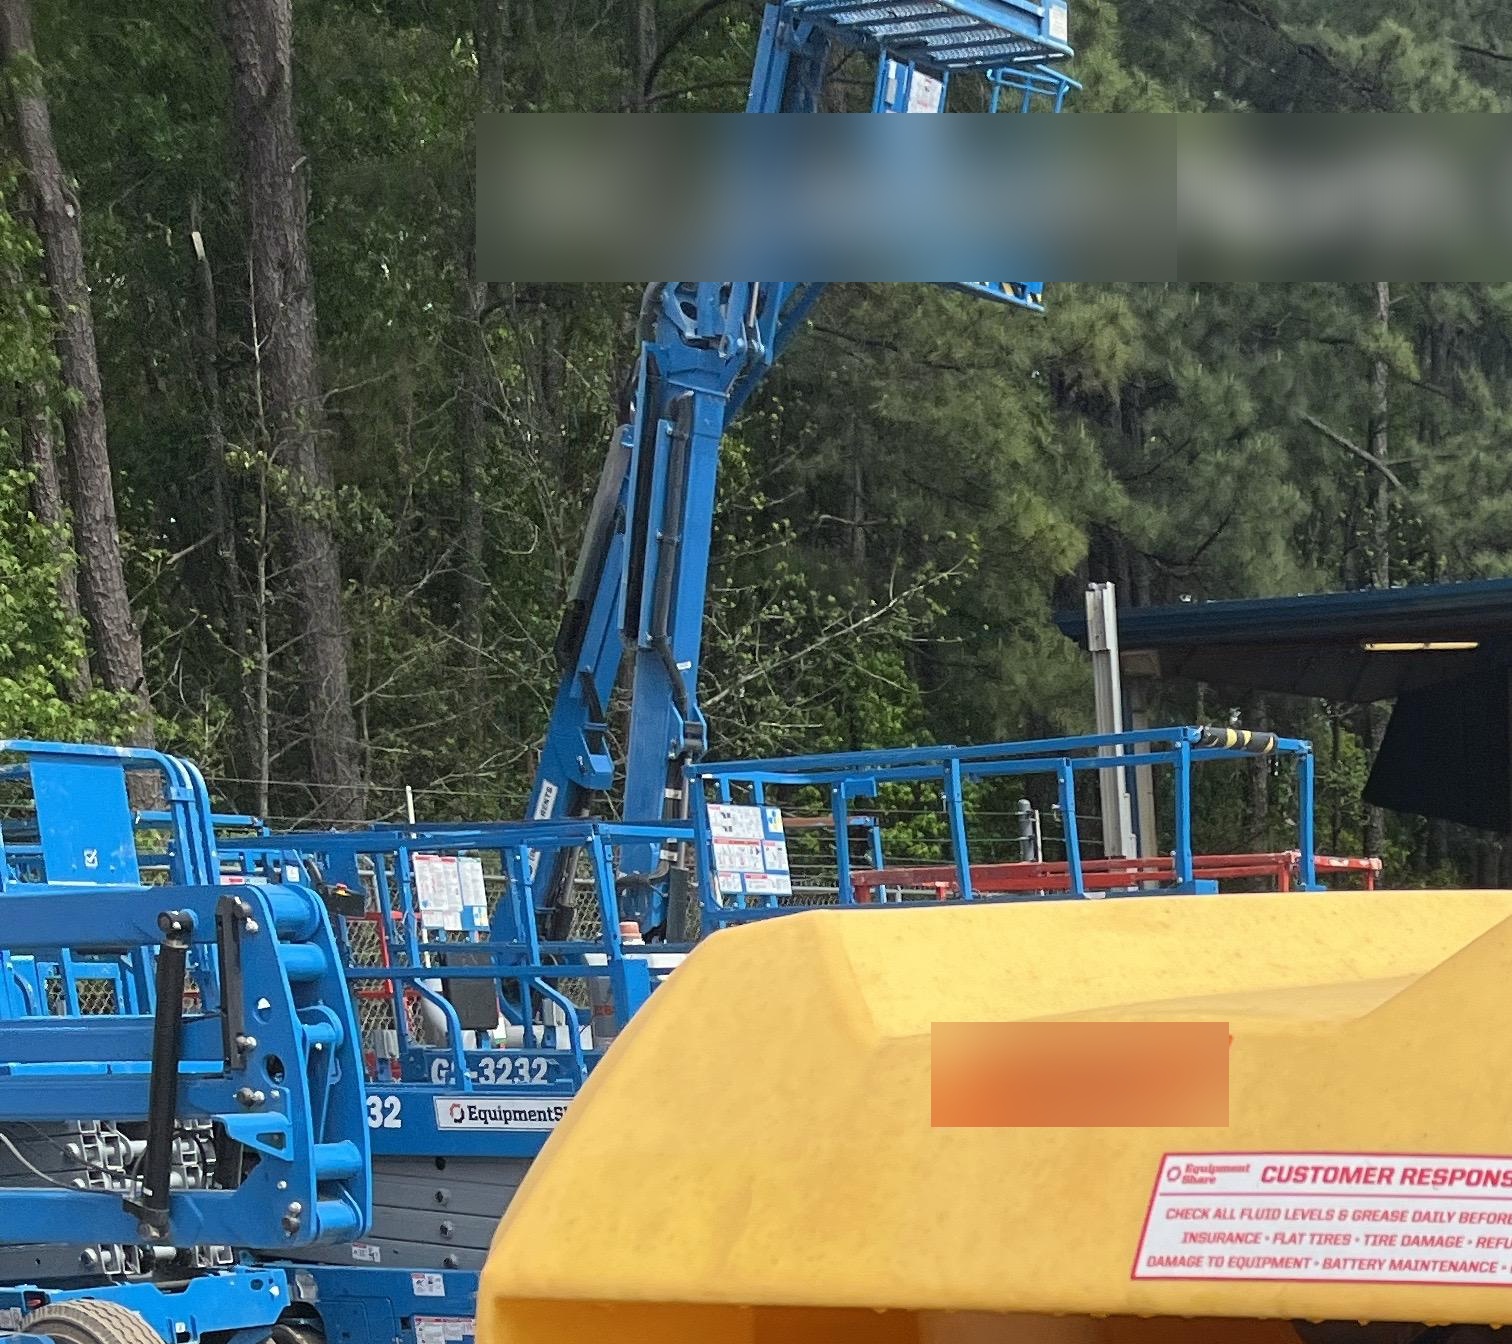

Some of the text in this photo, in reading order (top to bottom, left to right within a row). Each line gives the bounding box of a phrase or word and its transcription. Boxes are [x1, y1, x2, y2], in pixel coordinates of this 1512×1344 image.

[468, 1104, 567, 1125] EquipmentS
[1261, 1165, 1395, 1185] CUSTOMER
[1165, 1207, 1209, 1220] CHECK
[1213, 1207, 1236, 1220] ALL
[1240, 1207, 1281, 1221] FLUID
[1284, 1208, 1335, 1221] LEVELS
[1351, 1210, 1409, 1222] GREASE
[1411, 1210, 1456, 1224] DAILY
[1182, 1232, 1262, 1244] INSURANCE
[1272, 1232, 1306, 1245] FLAT
[1309, 1233, 1351, 1246] TIRES
[1363, 1234, 1398, 1247] TIRE
[1401, 1235, 1463, 1249] DAMAGE
[1146, 1256, 1203, 1268] DAMAGE
[1207, 1256, 1225, 1268] TO
[1227, 1256, 1311, 1270] EQUIPMENT
[1322, 1258, 1386, 1272] BATTERY
[1389, 1259, 1498, 1274] MAINTENANCE
